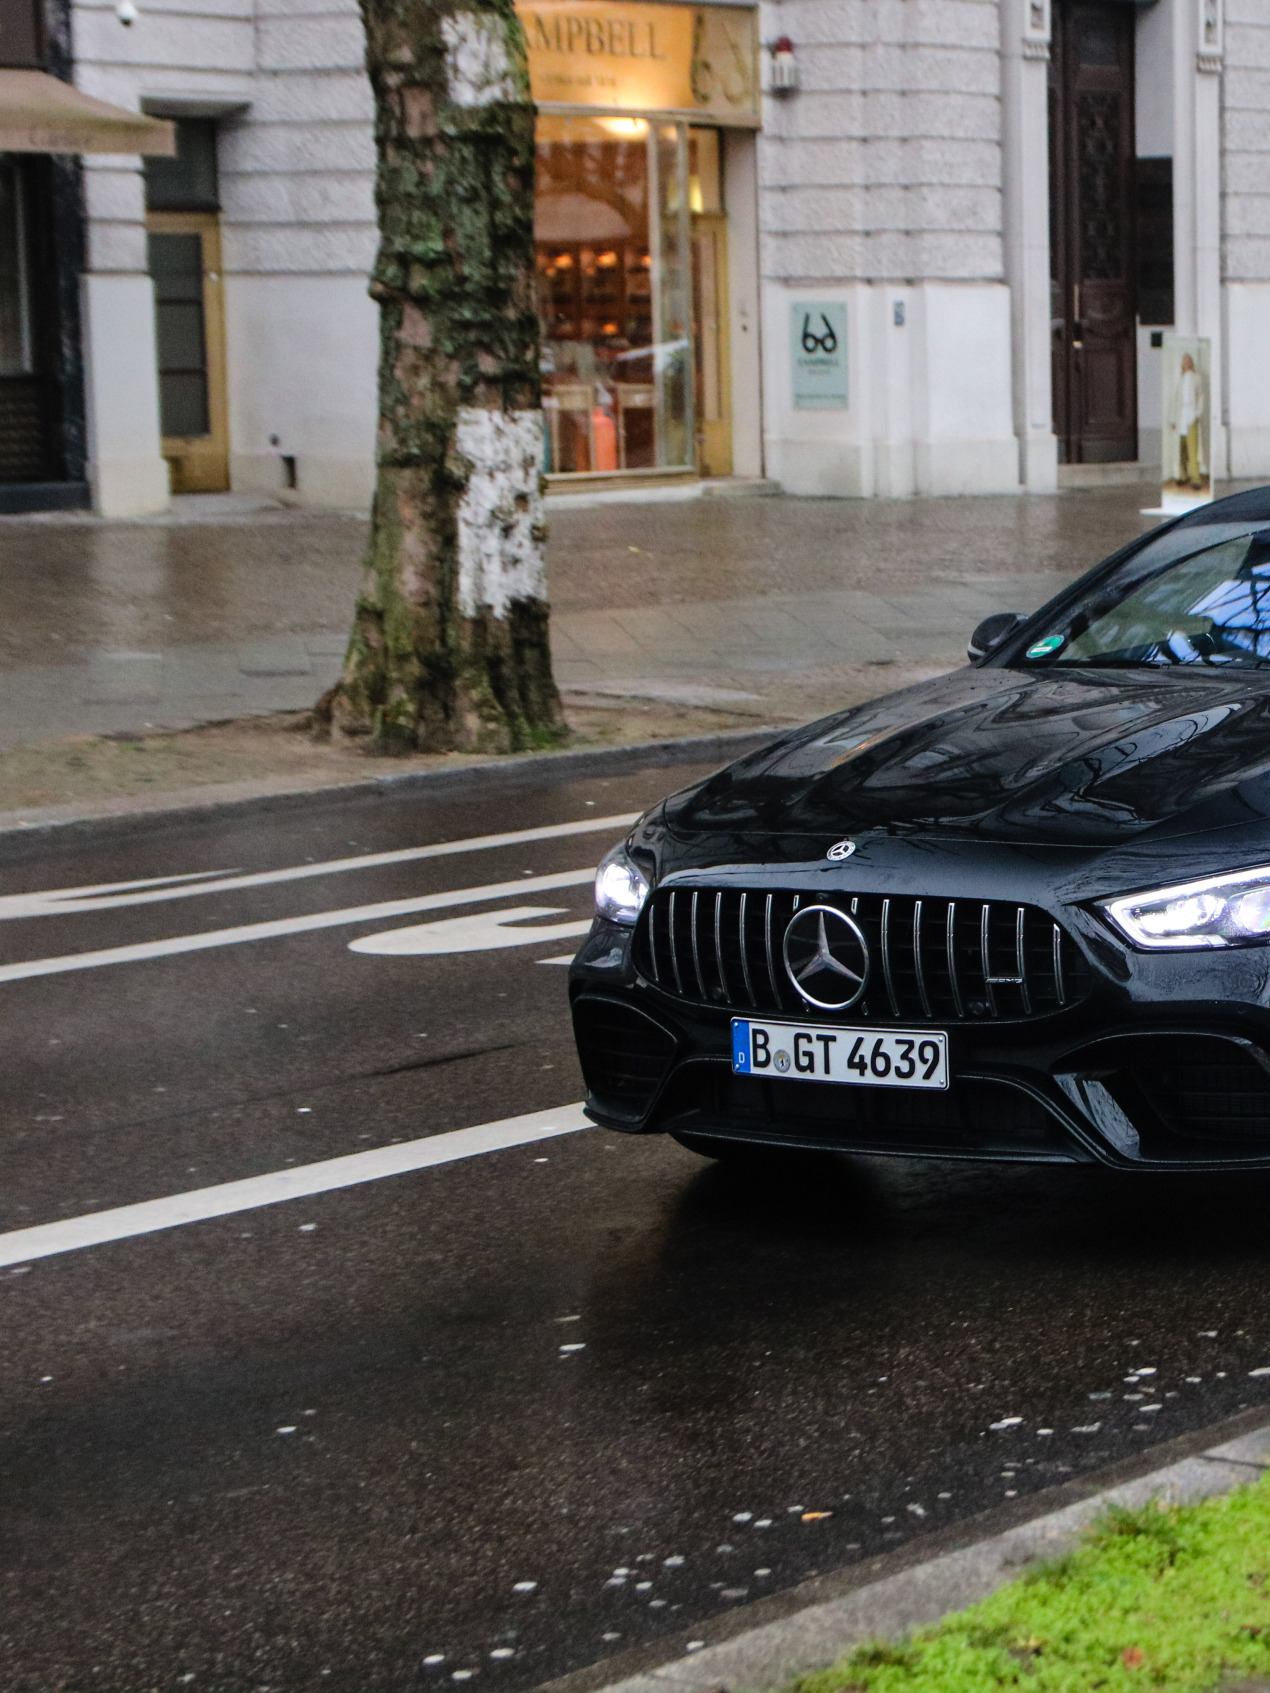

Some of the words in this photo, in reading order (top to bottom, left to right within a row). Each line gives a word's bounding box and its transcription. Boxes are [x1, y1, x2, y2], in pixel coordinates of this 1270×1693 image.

[738, 1051, 746, 1064] D
[751, 1028, 771, 1069] B
[793, 1032, 837, 1075] GT
[847, 1036, 941, 1081] 4639
